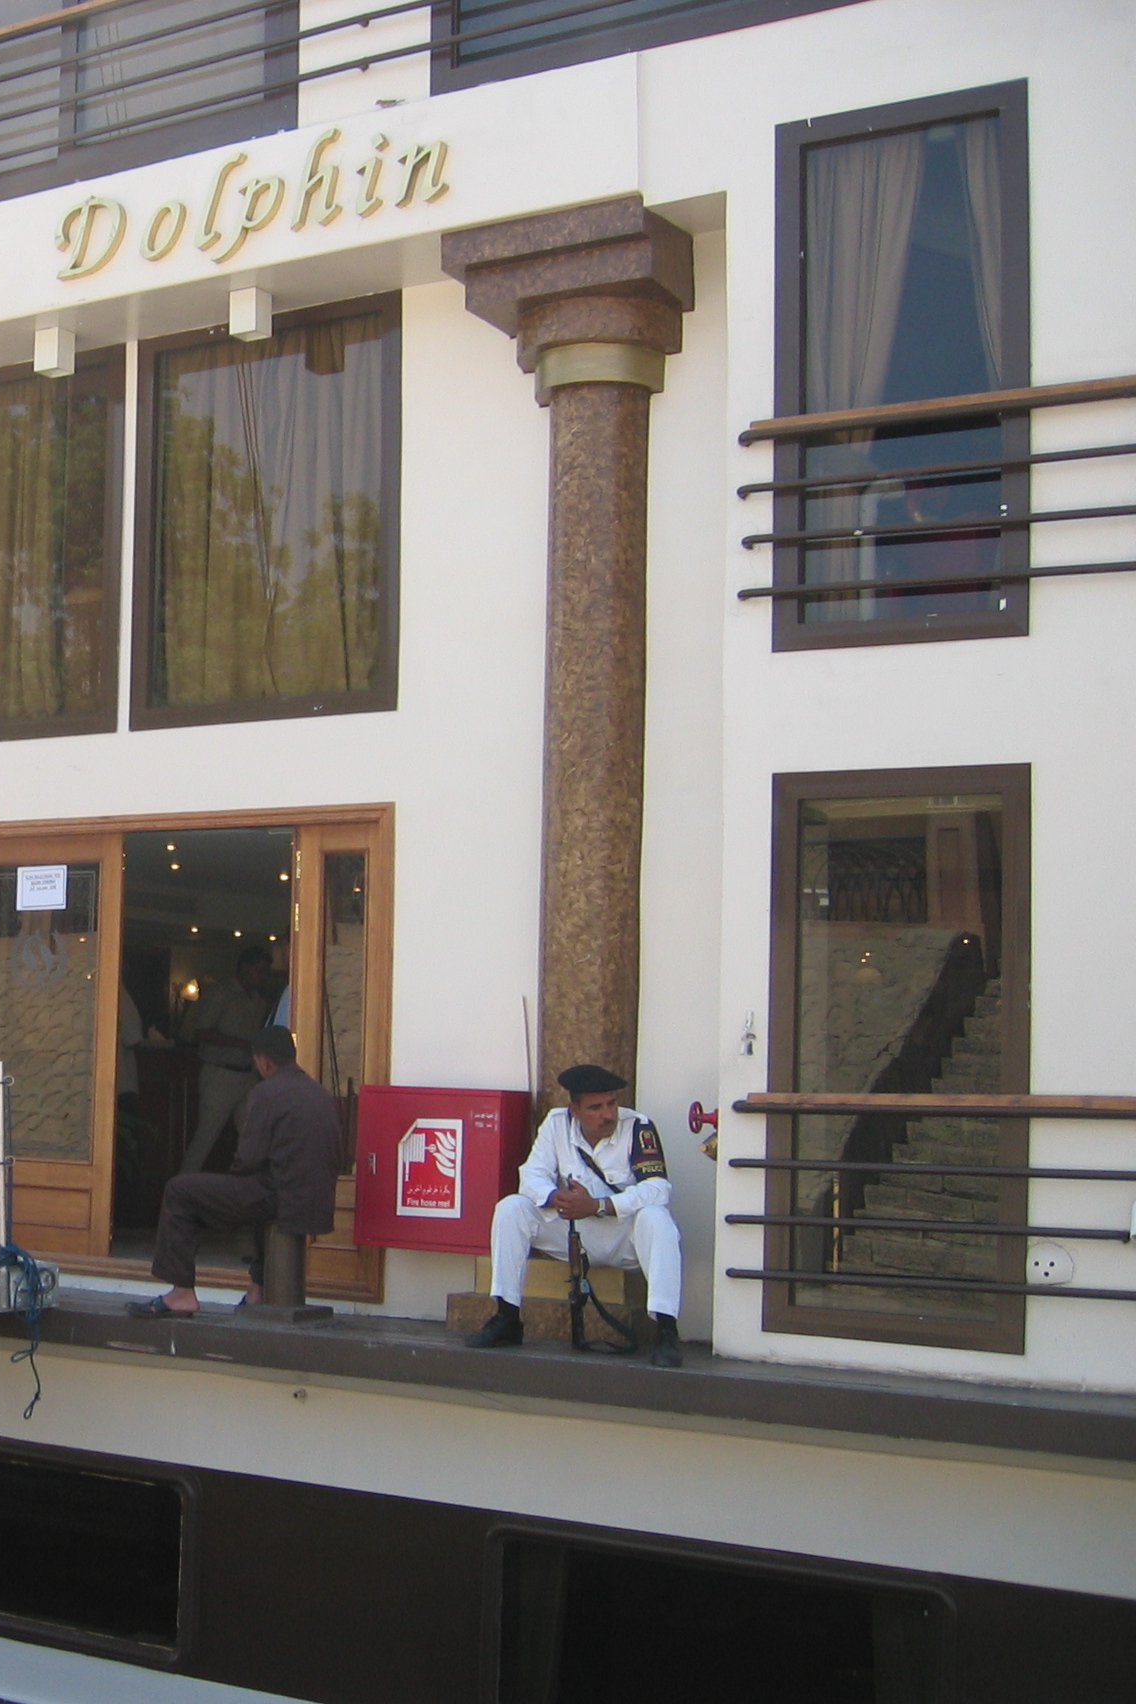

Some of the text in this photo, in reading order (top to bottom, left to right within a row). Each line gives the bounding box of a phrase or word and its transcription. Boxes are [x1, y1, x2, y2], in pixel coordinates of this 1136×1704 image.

[54, 127, 451, 282] Dolphin
[407, 1198, 419, 1206] Fire
[421, 1199, 437, 1207] hose
